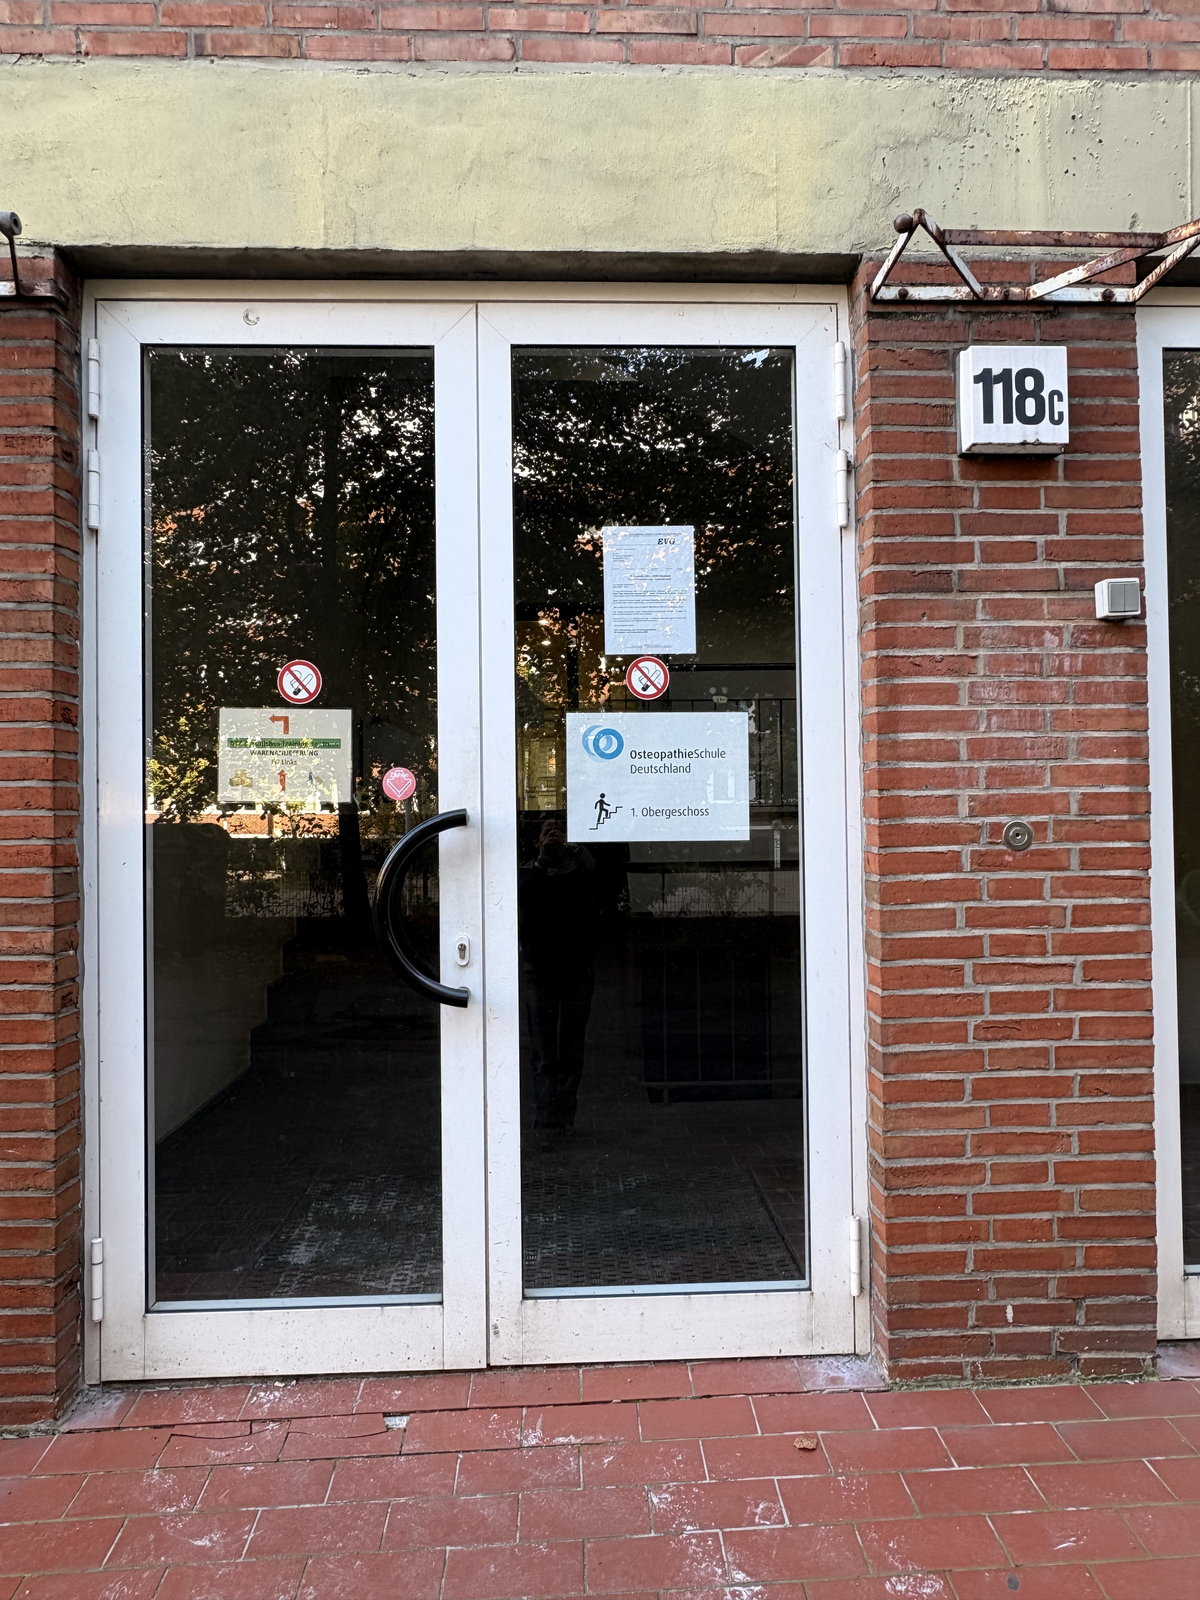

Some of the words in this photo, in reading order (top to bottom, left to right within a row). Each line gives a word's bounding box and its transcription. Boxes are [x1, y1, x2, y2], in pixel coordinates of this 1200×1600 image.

[657, 537, 676, 545] EVG
[629, 748, 726, 762] OsteopathieSchule
[630, 763, 691, 775] Deutschland
[630, 807, 639, 818] 1.
[641, 806, 710, 819] Obergeschoss
